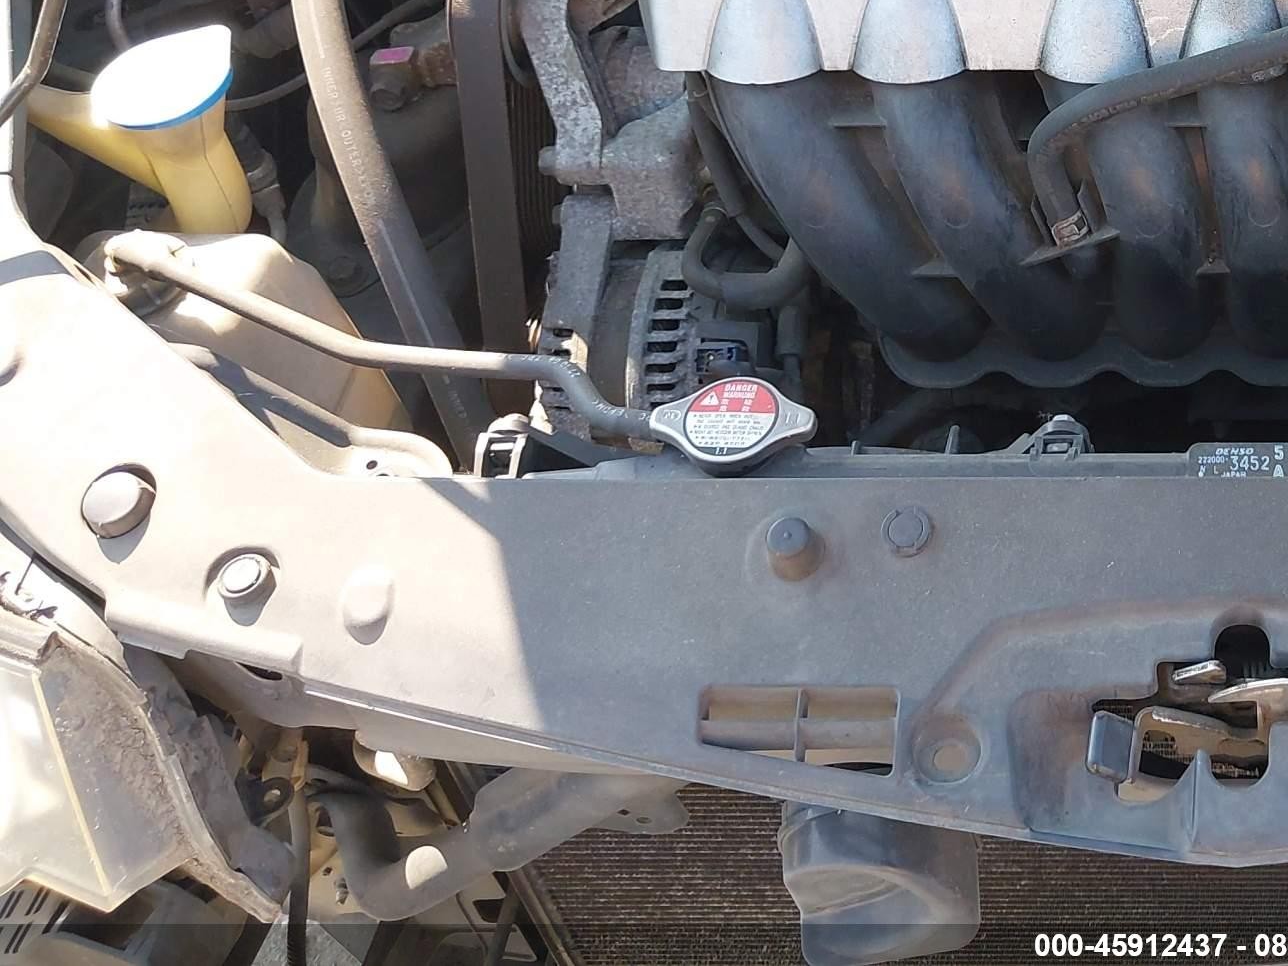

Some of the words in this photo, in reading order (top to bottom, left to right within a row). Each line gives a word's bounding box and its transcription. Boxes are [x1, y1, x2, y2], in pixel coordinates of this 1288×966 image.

[724, 384, 758, 392] DANGER
[1215, 447, 1254, 456] DENSO
[1273, 444, 1285, 461] 5
[1272, 464, 1285, 478] A
